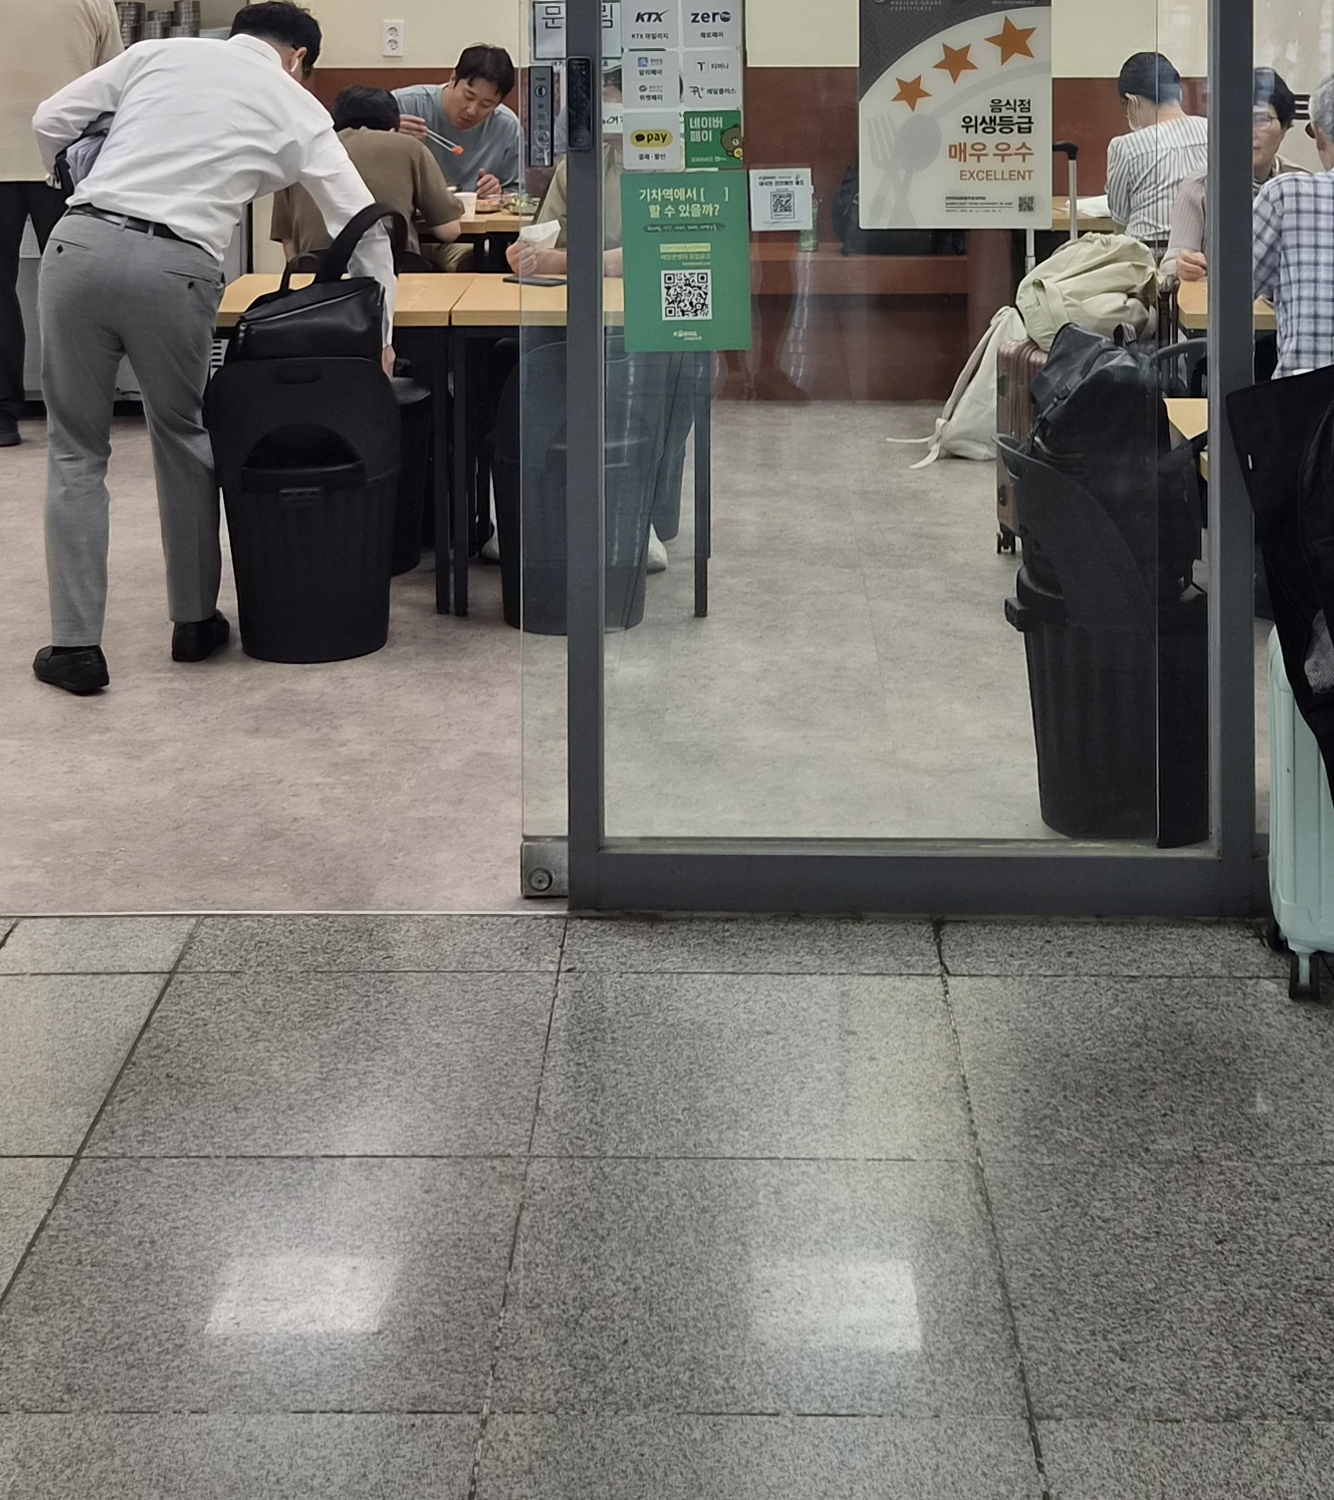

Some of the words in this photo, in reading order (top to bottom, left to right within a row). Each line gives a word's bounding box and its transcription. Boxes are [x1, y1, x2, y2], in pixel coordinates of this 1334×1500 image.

[635, 10, 670, 23] KTX
[989, 98, 1032, 114] 음식점
[689, 116, 723, 129] 네이버
[961, 115, 1034, 135] 위생등급
[647, 132, 667, 143] pay
[948, 142, 989, 163] 매우
[993, 142, 1034, 163] 우수
[959, 169, 1034, 181] EXCELLENT
[639, 187, 698, 202] 기차역에서
[648, 204, 660, 219] 할
[663, 204, 676, 218] 수
[679, 204, 720, 218] 있을까?
